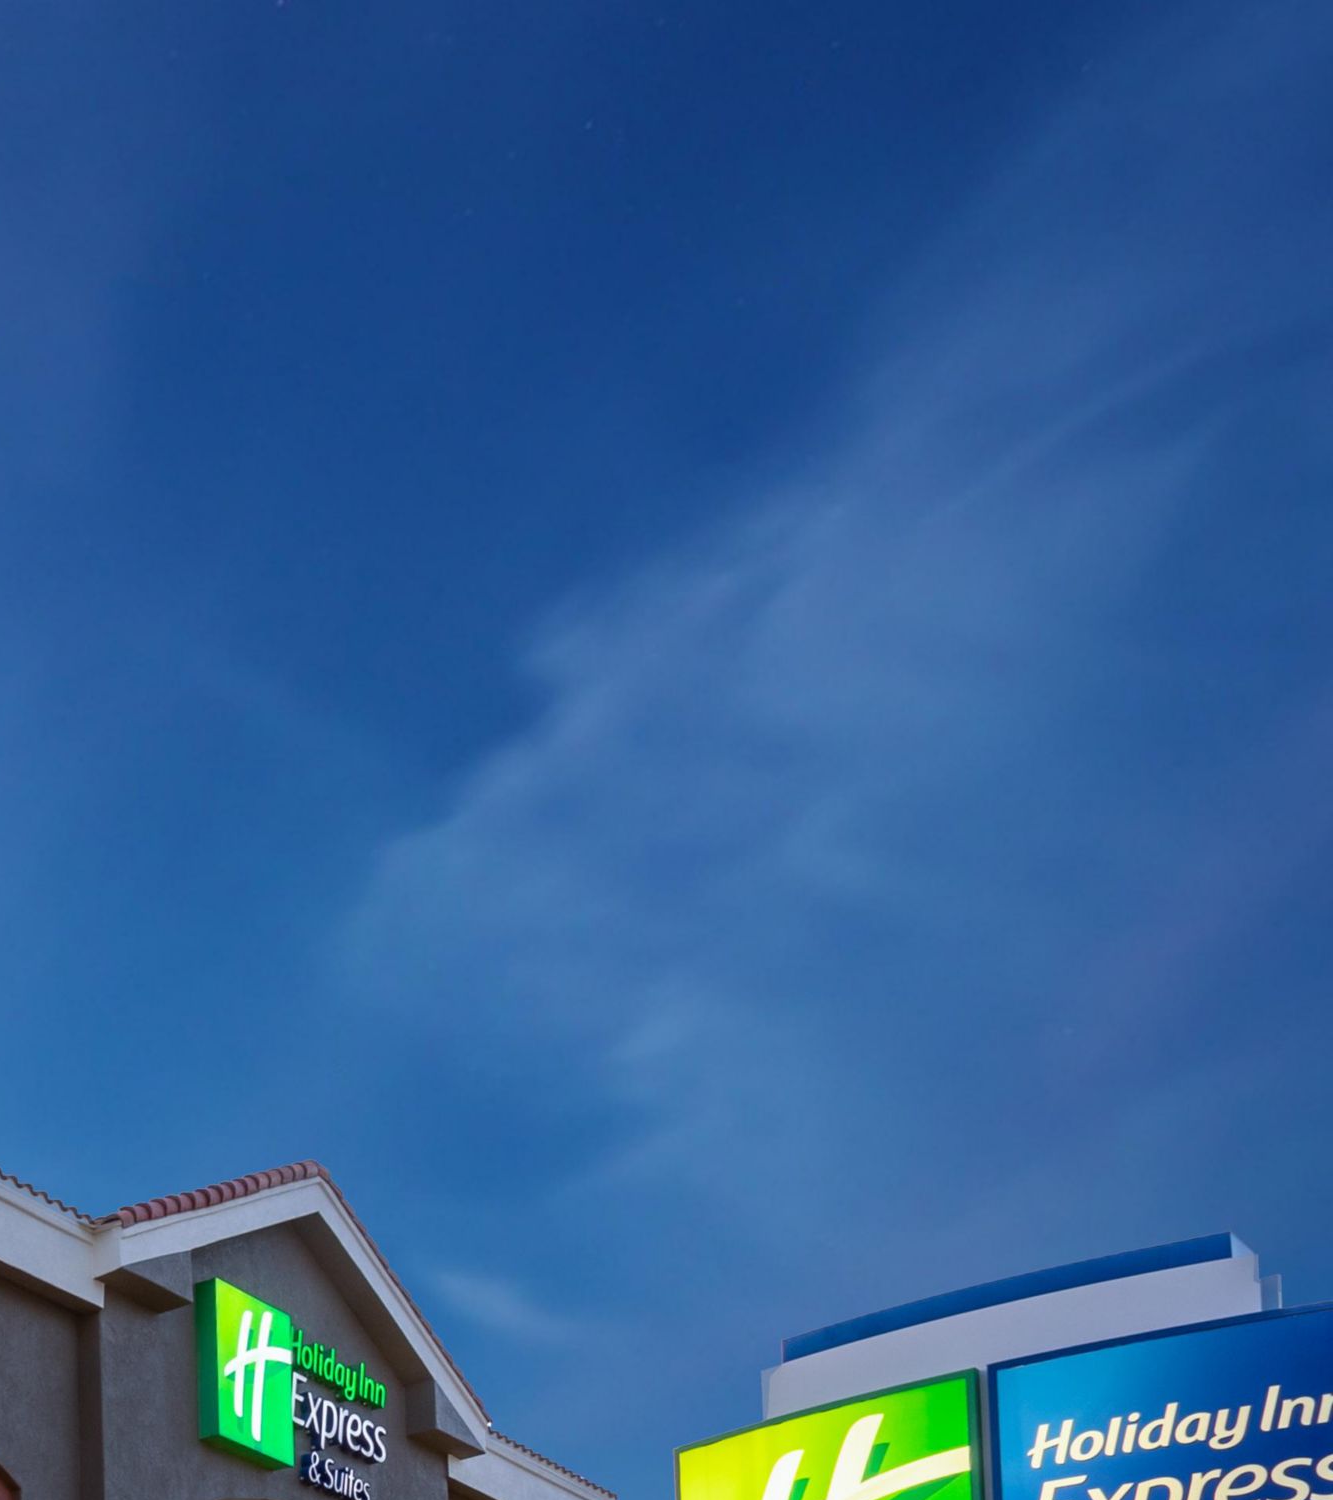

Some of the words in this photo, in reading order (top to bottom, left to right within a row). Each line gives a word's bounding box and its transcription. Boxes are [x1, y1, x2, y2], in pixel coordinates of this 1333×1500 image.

[290, 1325, 358, 1402] Holiday
[358, 1362, 387, 1409] Inn
[291, 1371, 388, 1464] Express
[1026, 1401, 1252, 1470] Holiday
[308, 1451, 322, 1484] &
